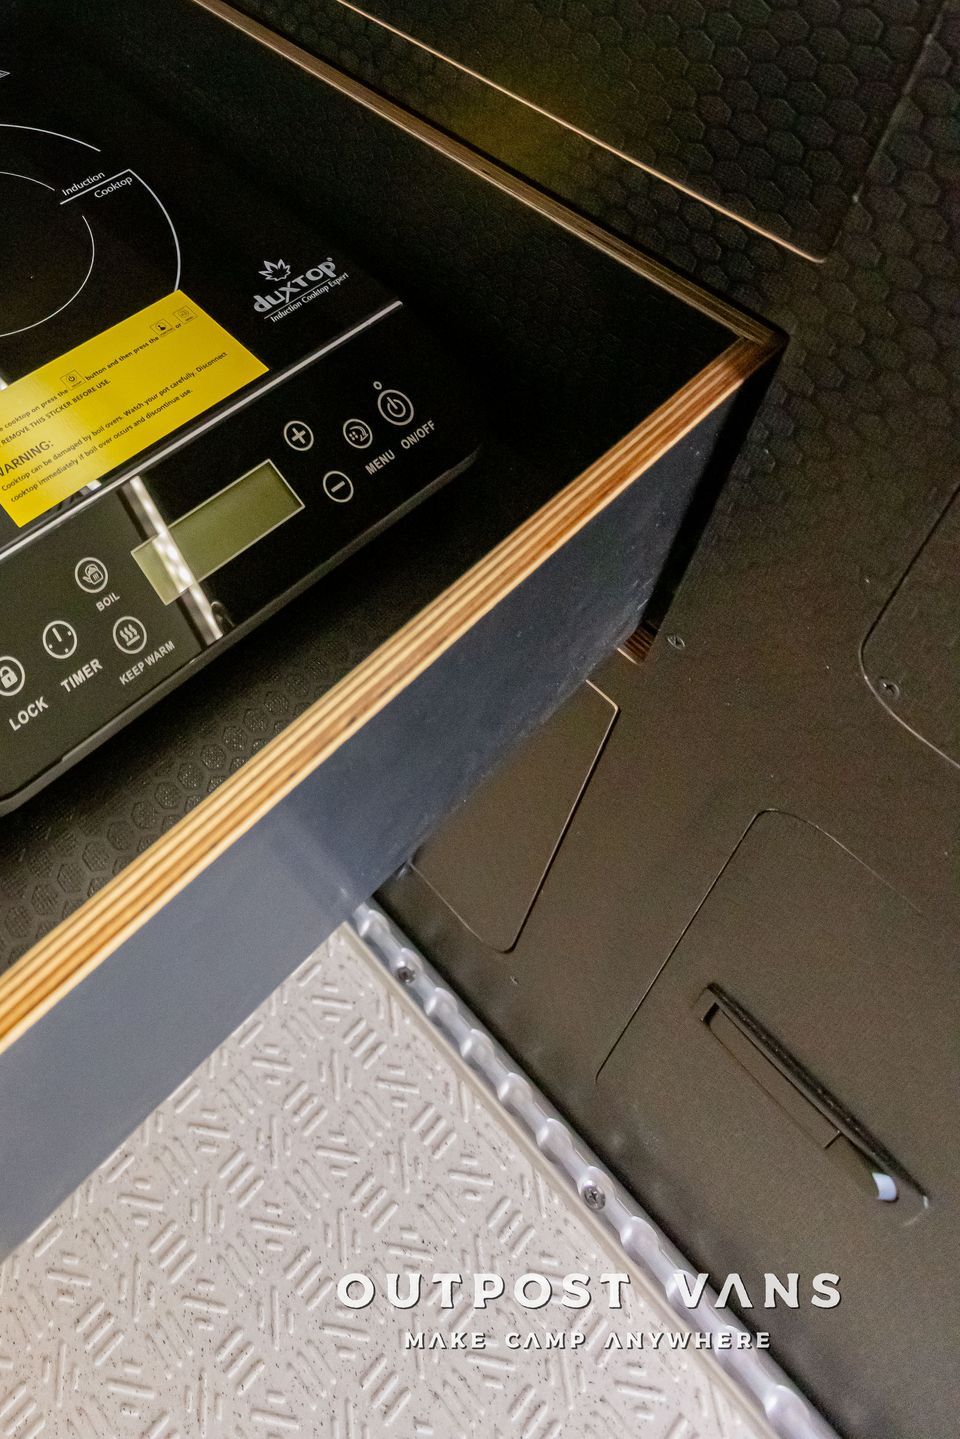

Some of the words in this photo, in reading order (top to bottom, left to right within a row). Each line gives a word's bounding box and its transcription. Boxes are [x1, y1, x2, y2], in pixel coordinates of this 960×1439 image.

[61, 172, 106, 196] Induction
[94, 176, 133, 198] Cooktop
[270, 302, 303, 323] Induction
[301, 285, 330, 304] Cooktop
[327, 272, 350, 288] Expert
[4, 410, 31, 428] cooktop
[41, 396, 58, 409] press
[58, 388, 69, 399] the
[84, 367, 107, 381] button
[107, 359, 119, 369] and
[119, 351, 133, 362] then
[133, 342, 150, 354] press
[148, 335, 160, 344] the
[1, 425, 31, 446] REMOVE
[30, 416, 46, 430] THIS
[45, 400, 73, 421] STICKER
[71, 386, 97, 404] BEFORE
[1, 471, 31, 491] Cooktop
[31, 463, 43, 474] can
[43, 457, 53, 466] be
[53, 439, 83, 461] damaged
[82, 434, 92, 446] by
[91, 425, 106, 436] boil
[123, 402, 145, 417] Watch
[144, 393, 159, 406] your
[158, 386, 170, 397] pot
[196, 352, 228, 373] Disconnect
[10, 482, 38, 502] cooktop
[38, 459, 80, 487] immediately
[78, 452, 85, 462] if
[84, 445, 98, 457] boil
[98, 437, 113, 449] over
[113, 425, 134, 440] occurs
[133, 416, 146, 428] and
[145, 396, 180, 420] discontinue
[180, 388, 193, 399] use.
[400, 420, 435, 449] ON/OFF
[365, 449, 396, 475] MENU
[96, 592, 120, 612] BOIL
[60, 658, 104, 693] TIMER
[119, 661, 145, 685] KEEP
[144, 640, 176, 666] WARM
[8, 696, 49, 731] LOCK
